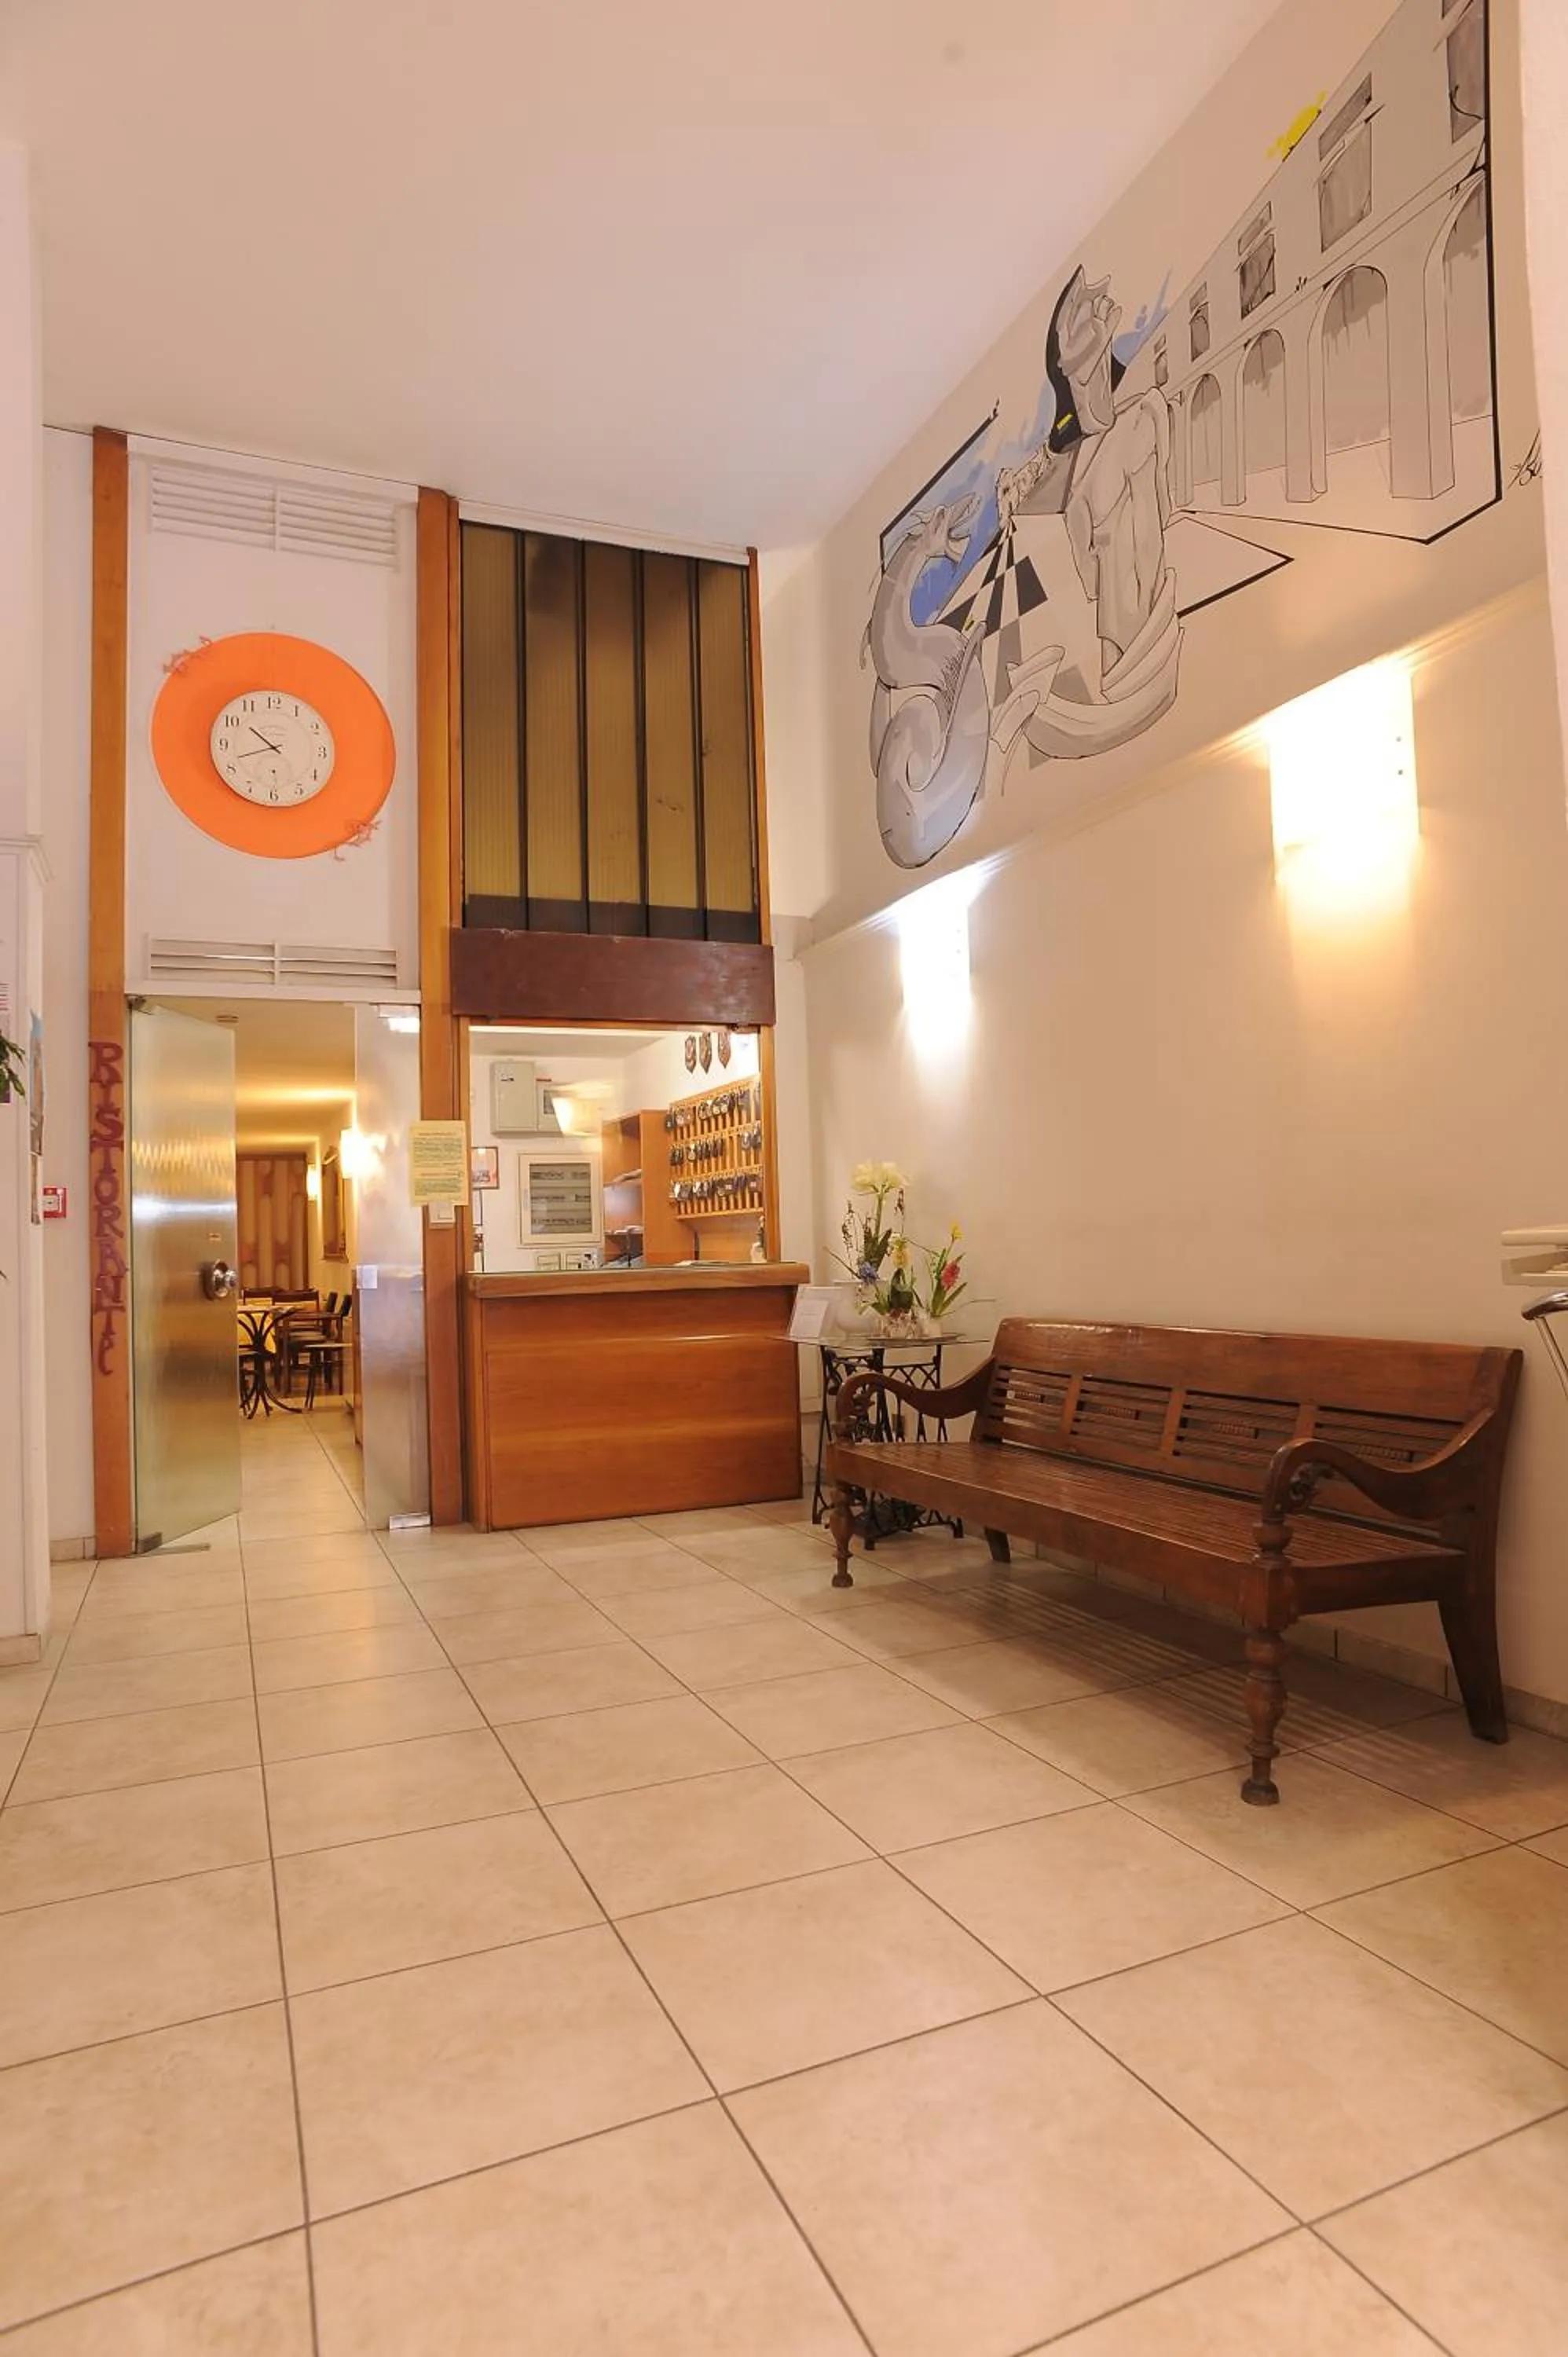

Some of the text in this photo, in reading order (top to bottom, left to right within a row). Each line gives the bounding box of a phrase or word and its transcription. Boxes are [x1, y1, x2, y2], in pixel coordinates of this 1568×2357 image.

[243, 698, 255, 713] 11
[268, 696, 282, 709] 12
[294, 705, 299, 717] 1
[225, 714, 240, 728] 10
[310, 722, 320, 735] 2
[219, 737, 229, 751] 9
[317, 746, 327, 759] 3
[226, 763, 236, 775] 8
[310, 768, 317, 781] 4
[246, 780, 252, 794] 7
[294, 783, 304, 795] 5
[269, 788, 279, 801] 6
